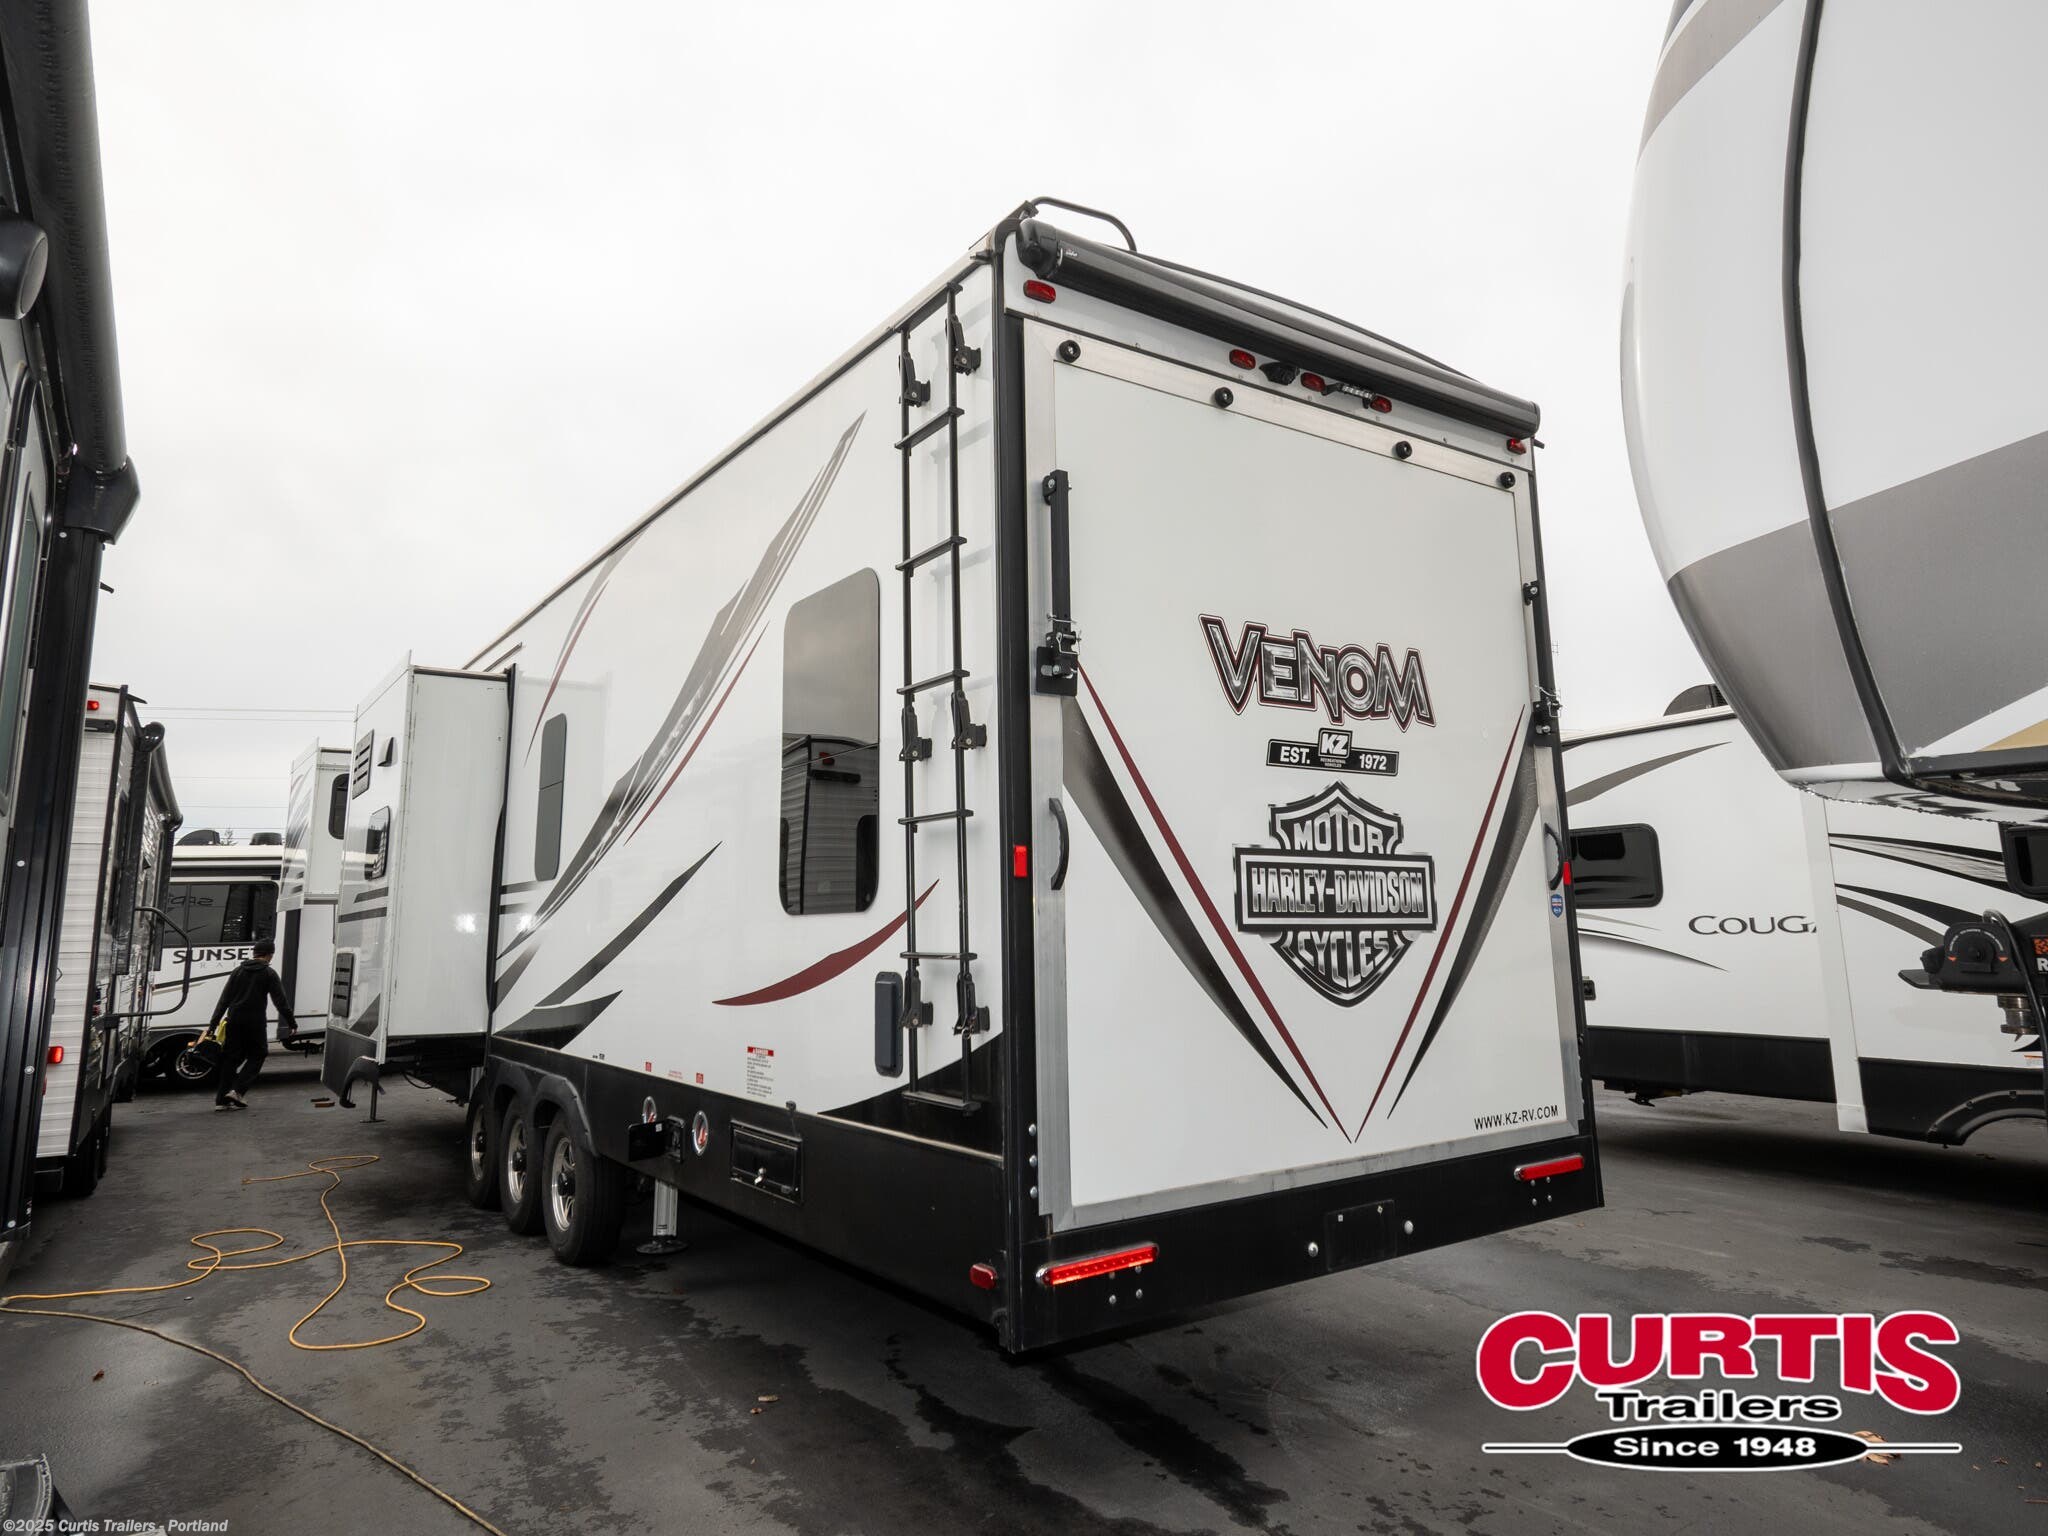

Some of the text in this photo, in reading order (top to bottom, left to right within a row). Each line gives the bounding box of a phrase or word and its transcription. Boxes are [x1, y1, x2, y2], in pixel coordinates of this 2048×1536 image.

[1199, 614, 1436, 732] VENOM
[1321, 733, 1348, 755] KZ
[1280, 746, 1387, 770] EST. 1972
[1293, 804, 1383, 854] MOTOR
[1251, 867, 1424, 914] HARLEY-DAVIDSON
[1688, 915, 1817, 935] COUG
[172, 948, 255, 964] SUNSE
[1297, 930, 1390, 988] CYCLES
[1473, 1104, 1559, 1130] WWW.KZ-RV.COM
